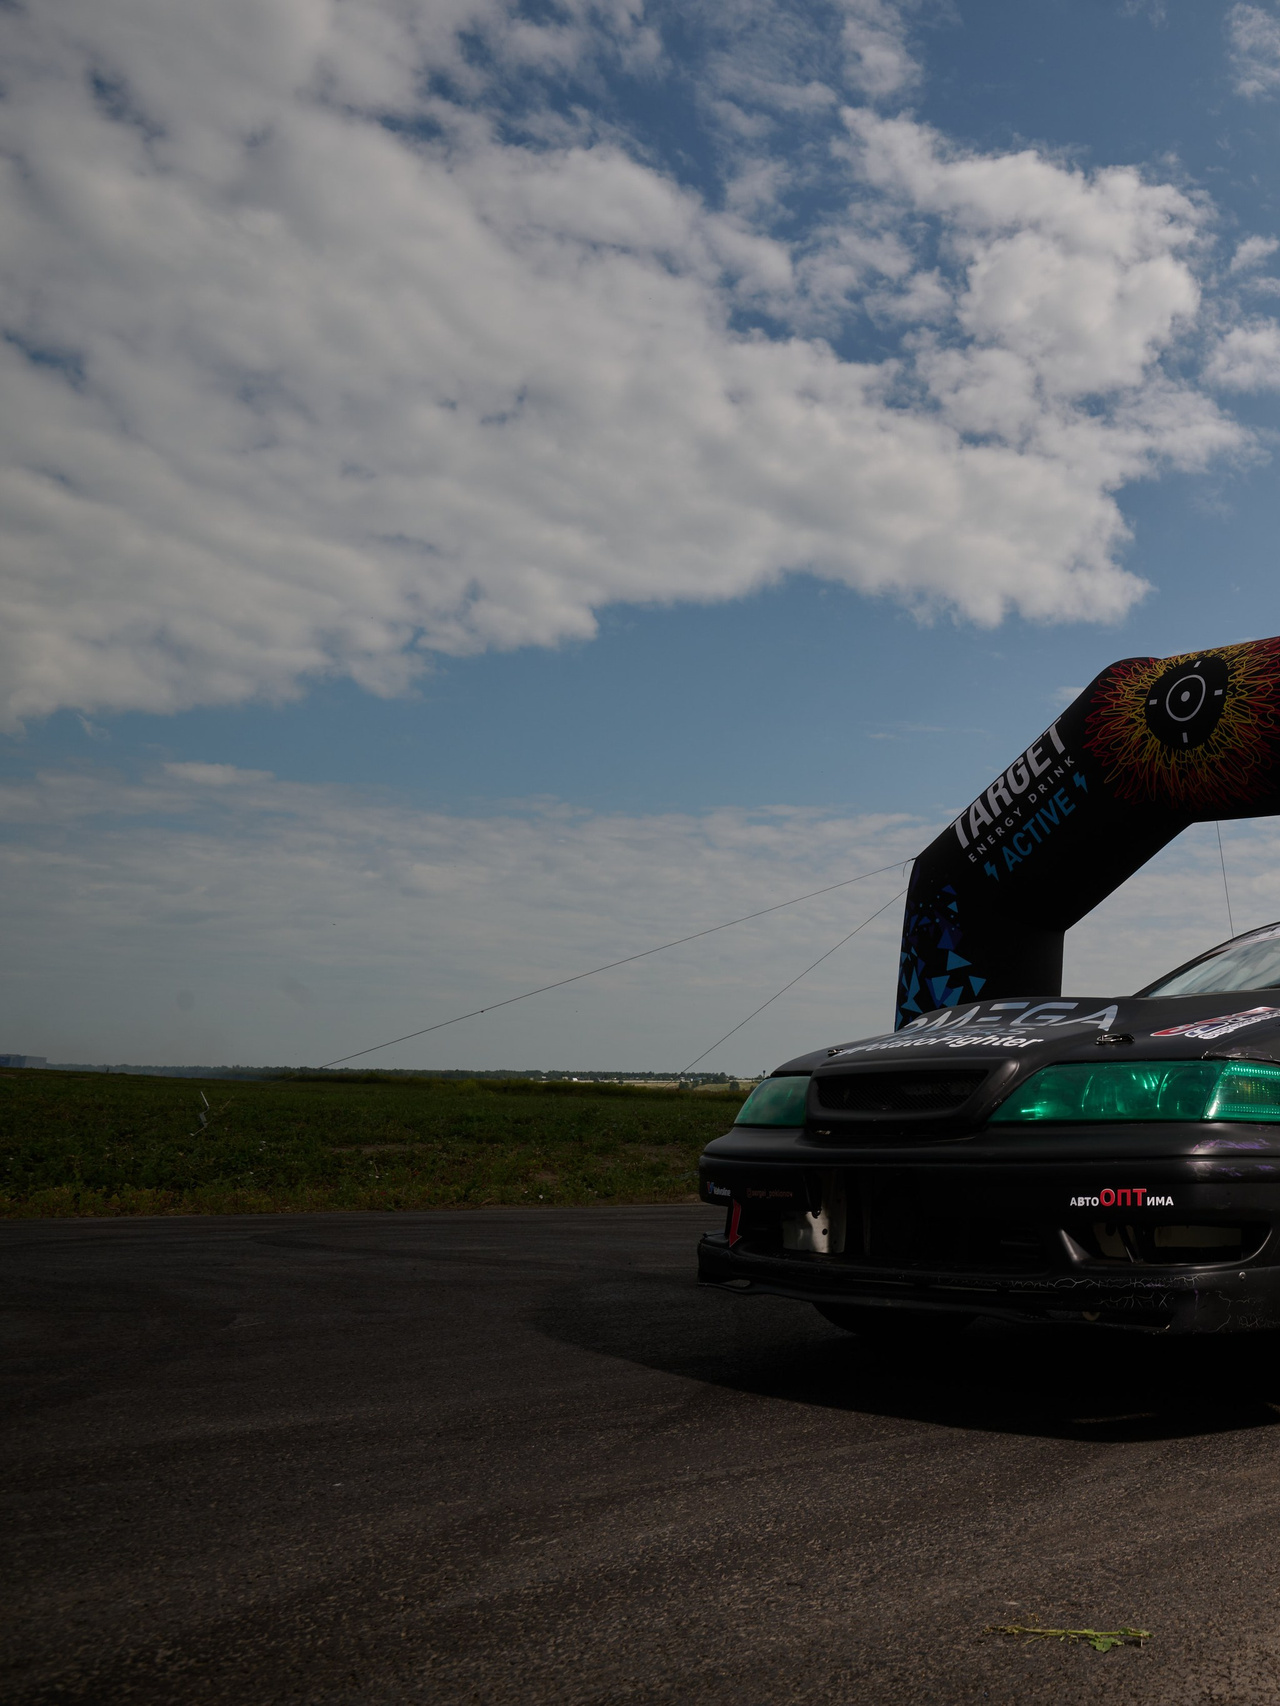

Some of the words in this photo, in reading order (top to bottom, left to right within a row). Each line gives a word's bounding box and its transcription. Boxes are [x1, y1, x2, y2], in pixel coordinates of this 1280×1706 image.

[950, 717, 1066, 849] TARGET
[968, 806, 1022, 863] ENERGY
[1027, 755, 1075, 804] DRINK
[1002, 787, 1076, 872] ACTIVE
